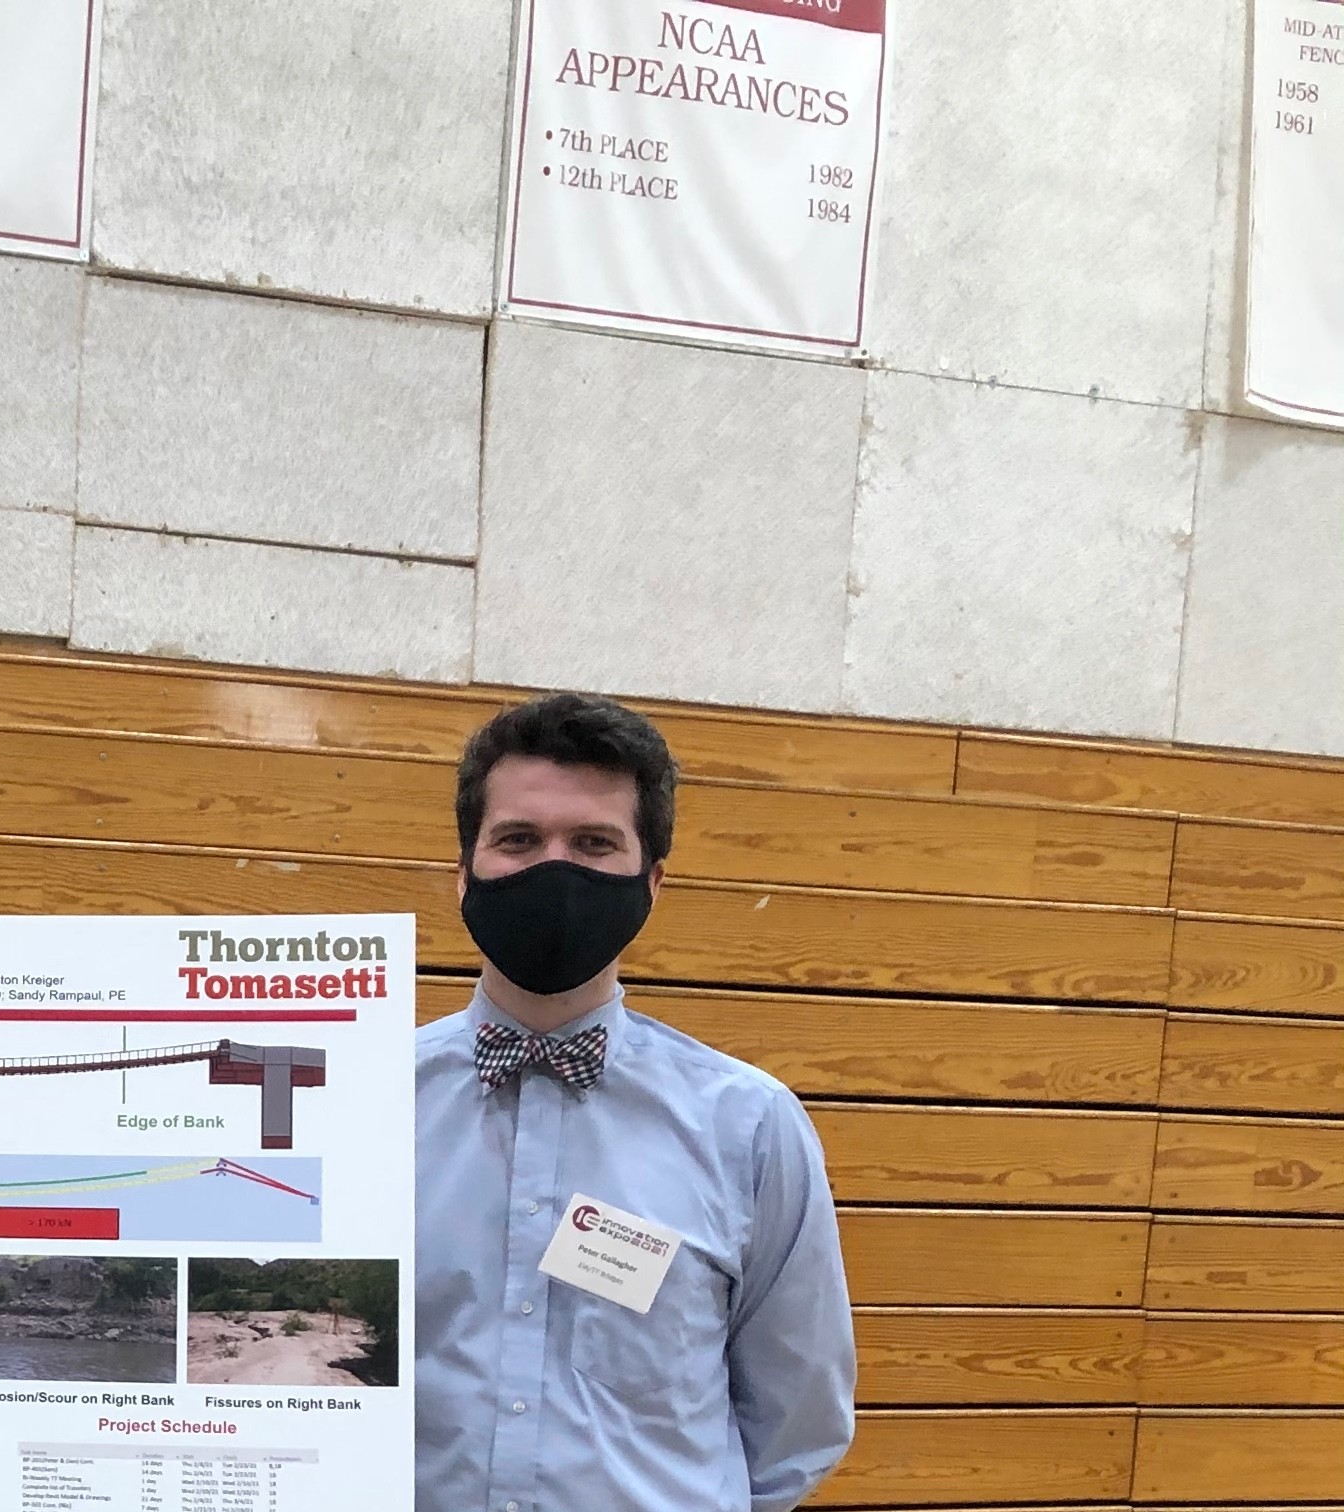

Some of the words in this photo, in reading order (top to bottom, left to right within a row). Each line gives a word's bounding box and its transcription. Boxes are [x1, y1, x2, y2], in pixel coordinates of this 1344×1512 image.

[657, 11, 766, 64] NCAA
[555, 48, 848, 126] APPEARANCES
[1277, 78, 1319, 103] 1958
[1275, 111, 1313, 134] 1961
[560, 128, 592, 153] 7th
[600, 134, 668, 163] PLACE
[560, 165, 602, 190] 12th
[610, 172, 678, 200] PLACE
[809, 164, 853, 189] 1982
[808, 198, 851, 224] 1984
[179, 930, 387, 962] Thornton
[178, 966, 387, 1000] Tomasetti
[117, 1114, 158, 1131] Edge
[163, 1115, 179, 1128] of
[184, 1115, 224, 1128] Bank
[602, 1217, 670, 1249] innovation
[578, 1244, 600, 1258] Peter
[81, 1396, 98, 1404] on
[102, 1394, 137, 1407] Right
[141, 1394, 174, 1406] Bank
[206, 1396, 262, 1408] Fissures
[266, 1400, 283, 1408] on
[288, 1398, 323, 1412] Right
[327, 1398, 361, 1410] Bank
[99, 1418, 156, 1434] Project
[161, 1420, 237, 1434] Schedule
